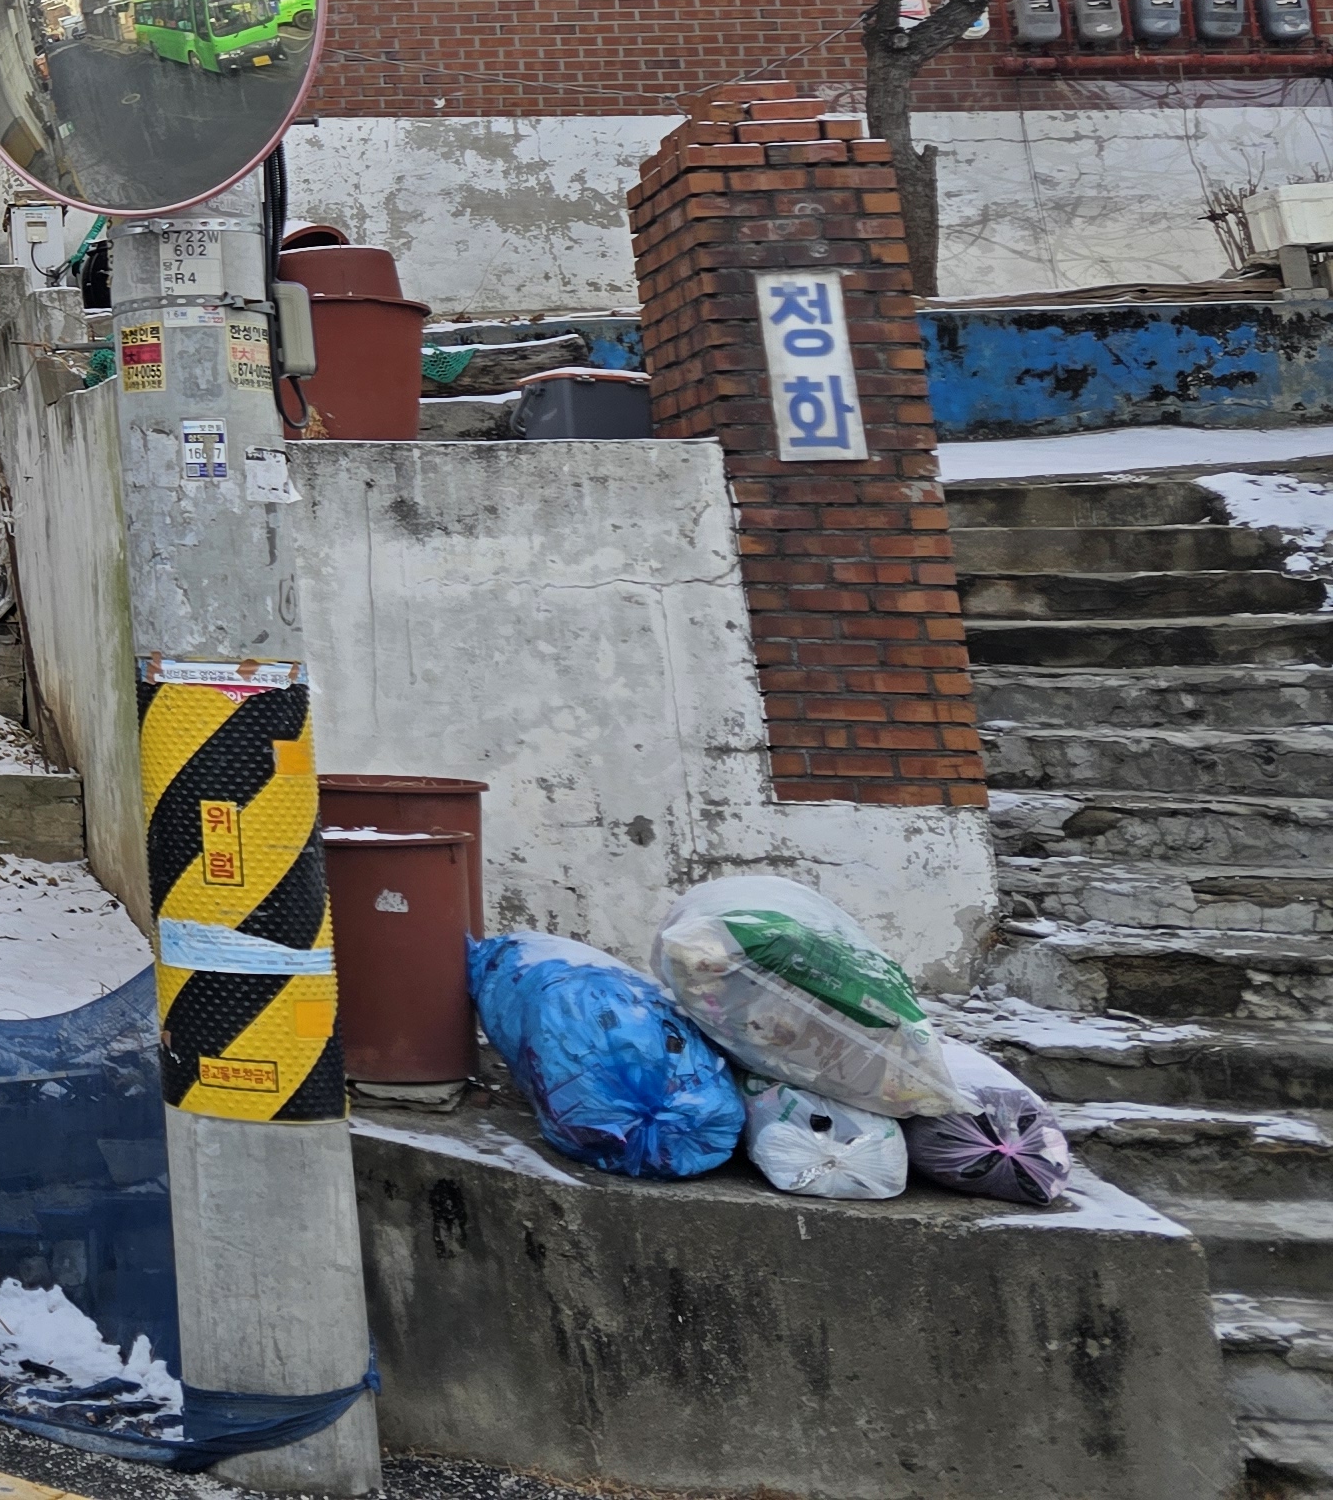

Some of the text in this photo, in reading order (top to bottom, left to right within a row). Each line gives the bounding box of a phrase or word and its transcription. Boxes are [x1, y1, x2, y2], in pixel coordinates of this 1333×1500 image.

[174, 244, 208, 257] 602
[206, 806, 235, 880] 위험
[201, 1064, 276, 1086] 광고물부착금지
